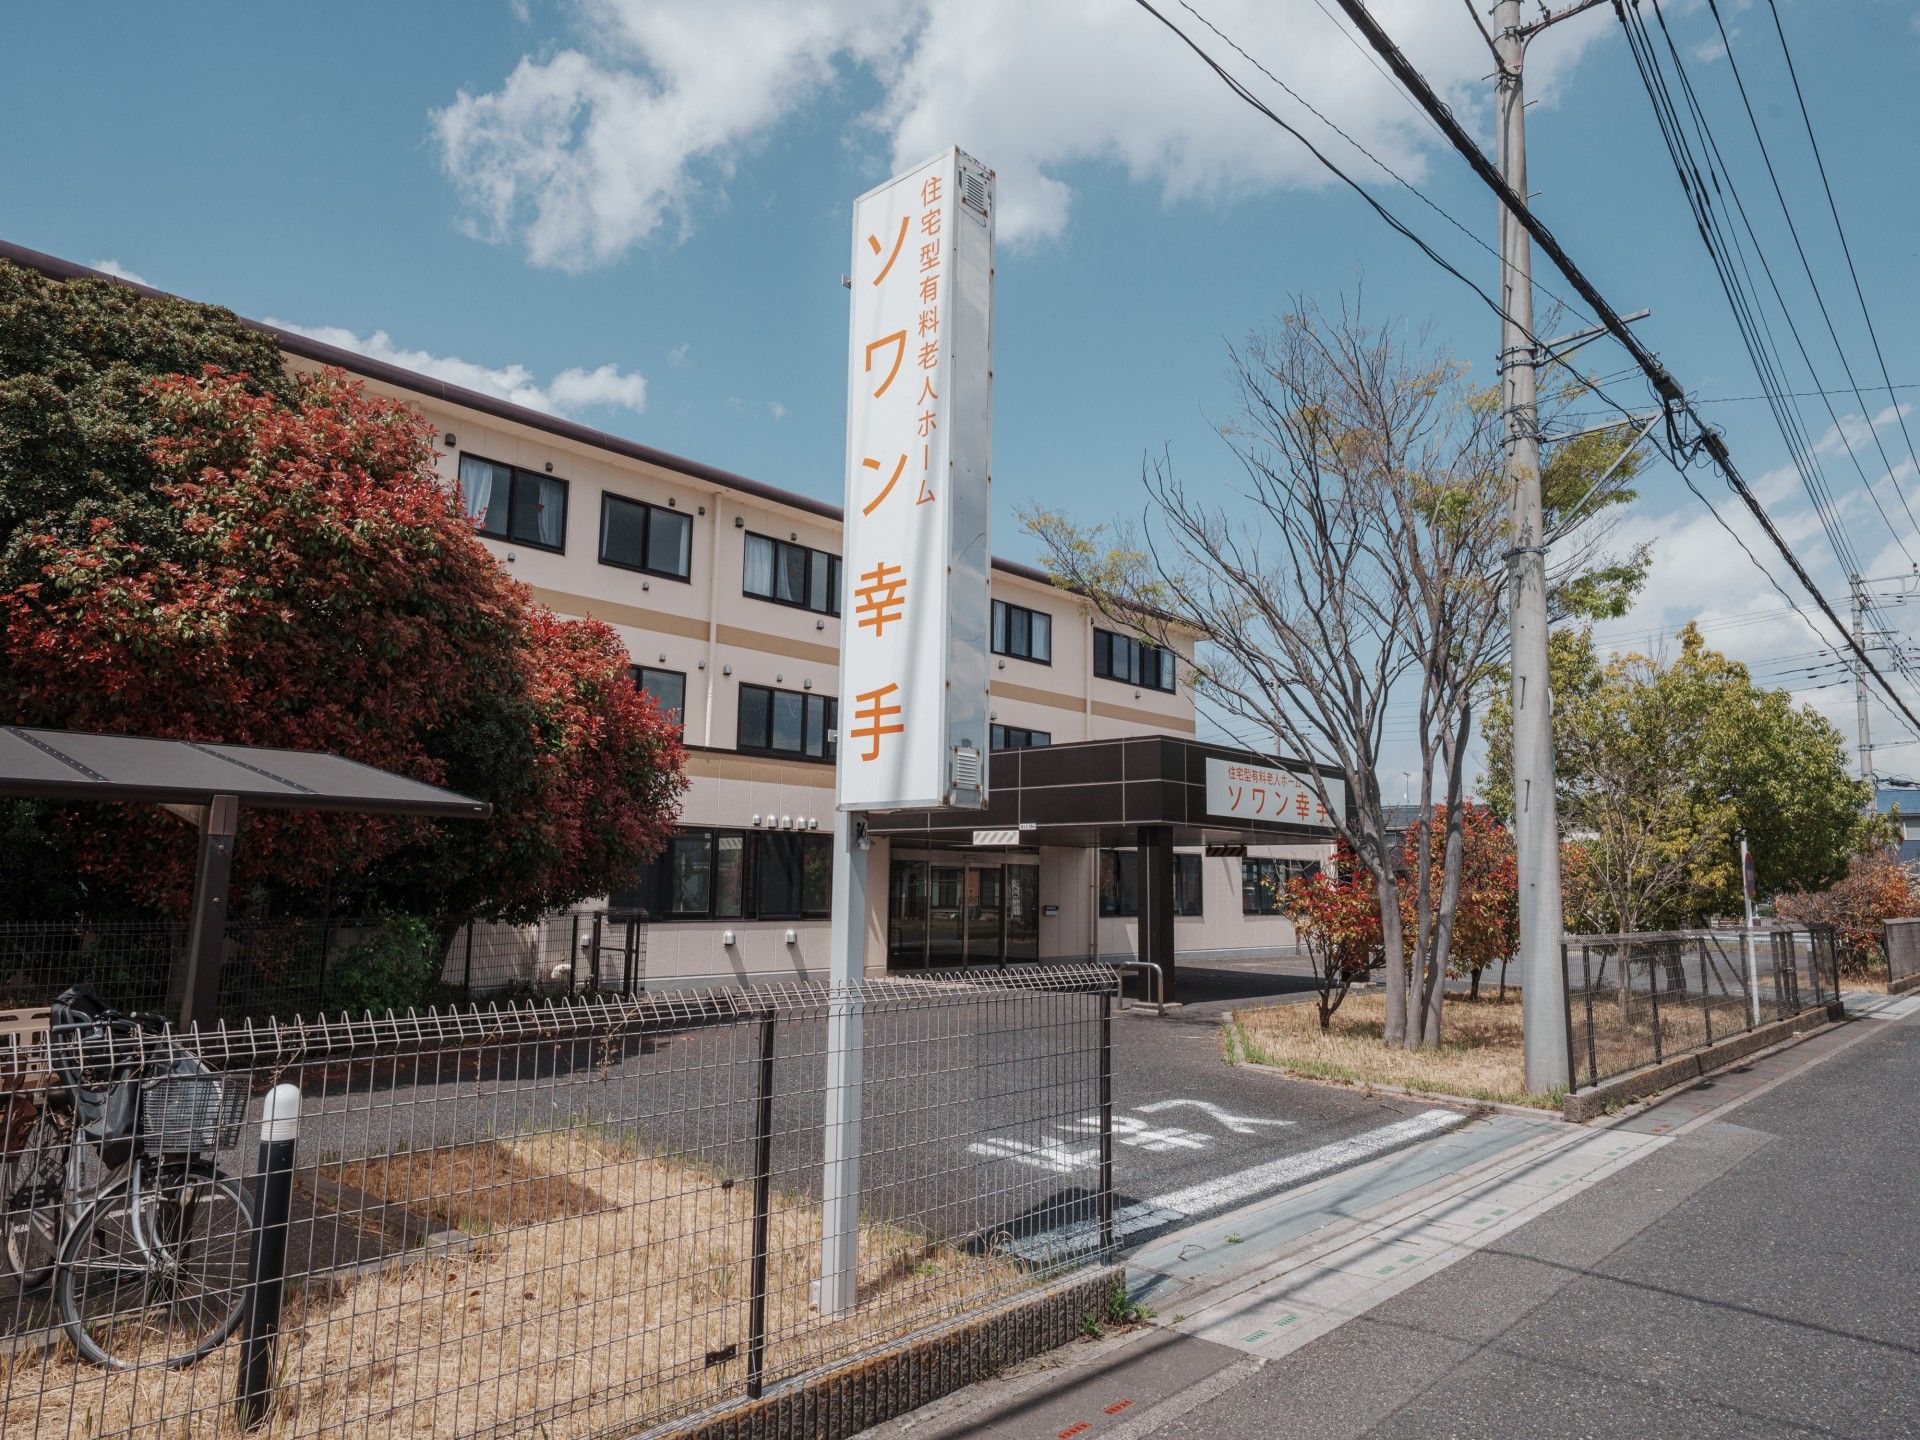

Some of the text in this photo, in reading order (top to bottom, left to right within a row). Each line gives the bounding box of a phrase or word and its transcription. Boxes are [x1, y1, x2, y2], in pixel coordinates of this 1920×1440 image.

[850, 215, 911, 762] ソワン幸手
[916, 176, 943, 506] 住宅型有料老人ホーム
[1227, 765, 1301, 788] 住宅型有料老人ホーム
